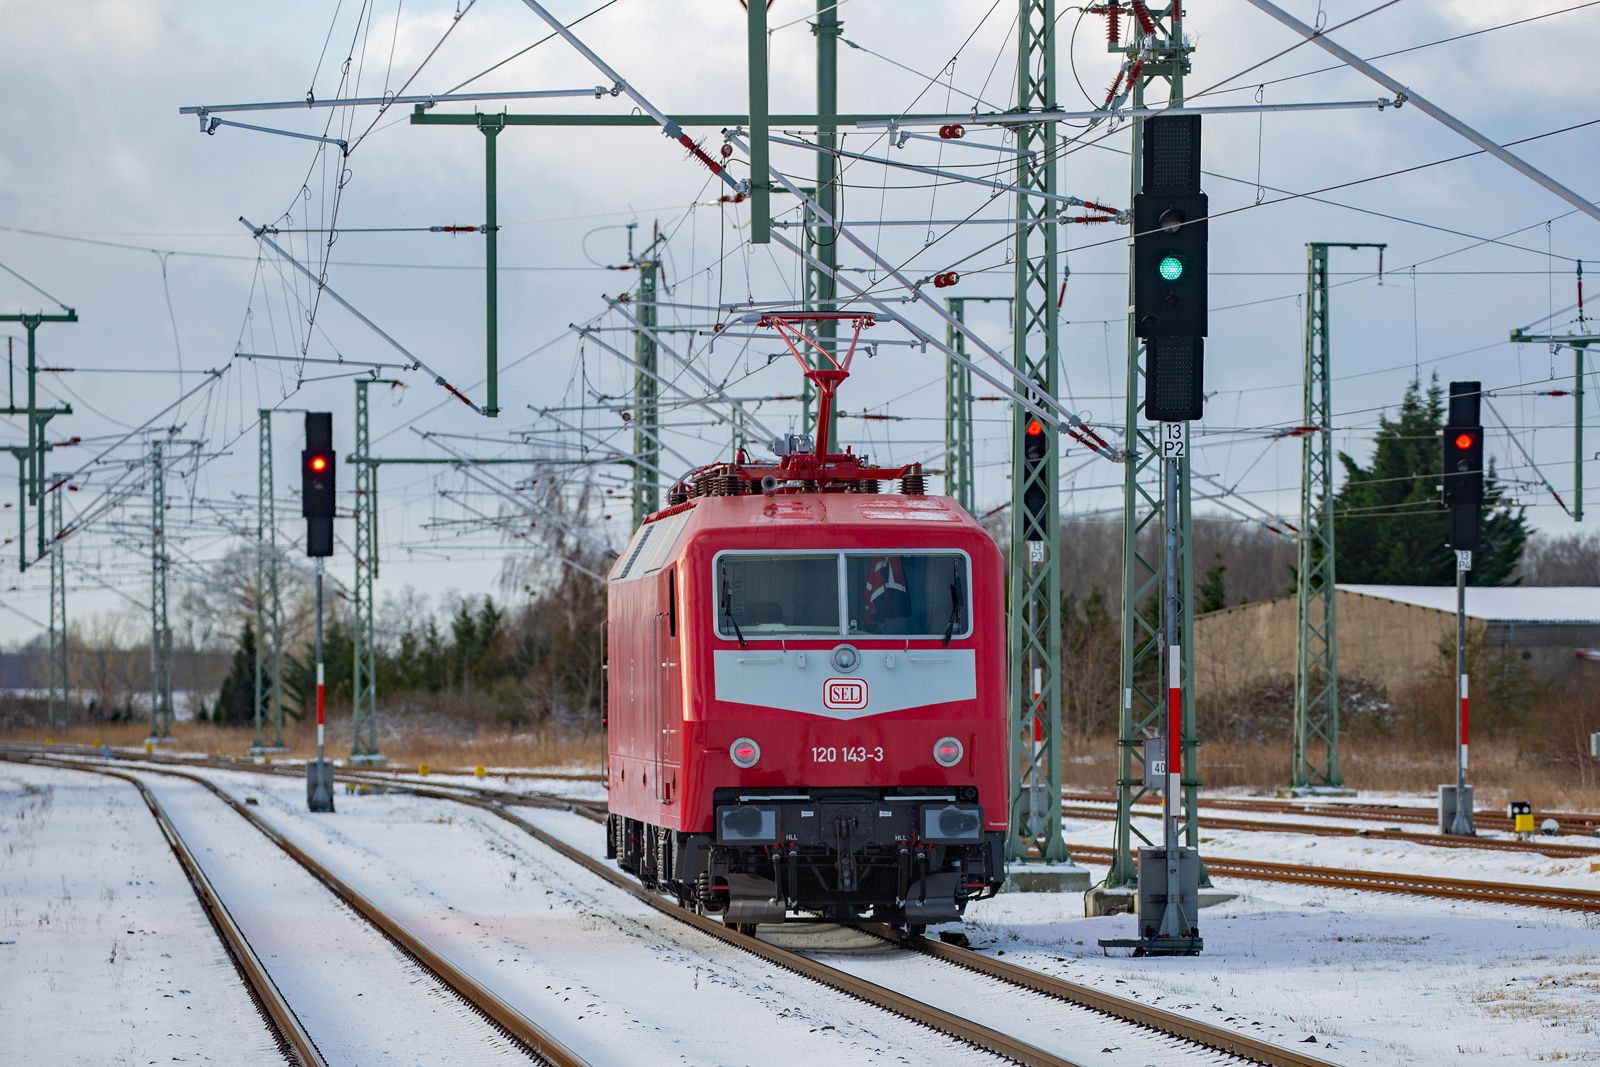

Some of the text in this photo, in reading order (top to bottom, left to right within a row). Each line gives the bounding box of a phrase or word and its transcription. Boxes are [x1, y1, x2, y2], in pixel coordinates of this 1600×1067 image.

[1166, 423, 1182, 440] 13
[1164, 441, 1184, 456] P2
[1032, 541, 1042, 551] 13
[1031, 551, 1043, 561] P3
[1460, 551, 1470, 560] 13
[1459, 560, 1471, 569] P4
[832, 687, 859, 701] SEL
[811, 746, 884, 762] 120 143-3
[1154, 762, 1166, 773] 40
